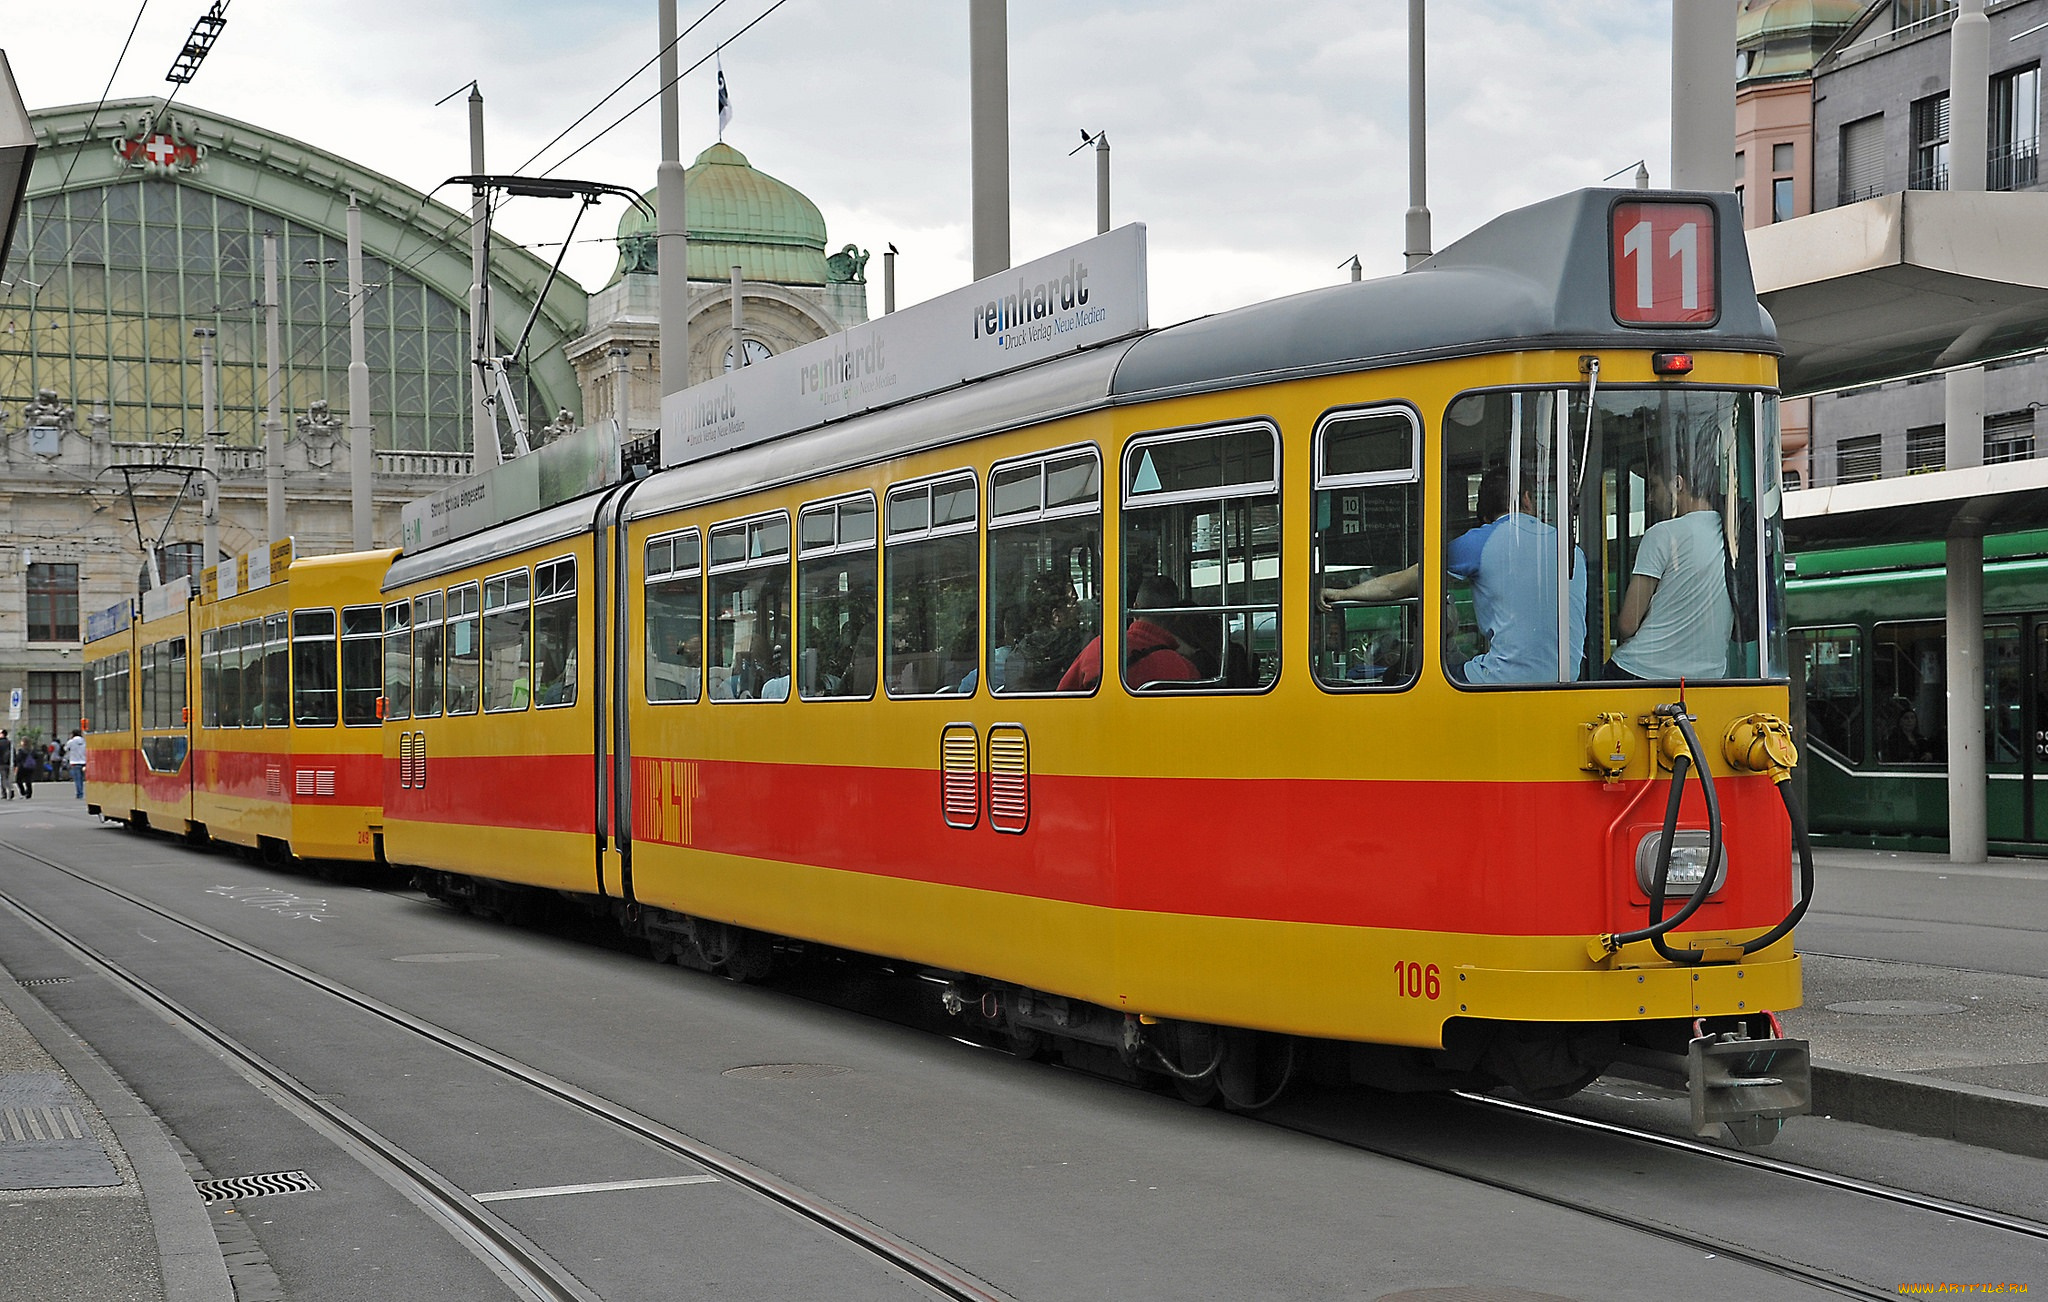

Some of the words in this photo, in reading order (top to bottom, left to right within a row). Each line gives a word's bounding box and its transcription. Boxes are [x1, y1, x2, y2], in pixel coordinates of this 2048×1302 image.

[1623, 220, 1699, 311] 11
[973, 258, 1089, 340] reinhardt
[1005, 330, 1027, 350] Druck
[1028, 324, 1052, 341] Verlag
[1054, 317, 1075, 335] Neue
[1075, 306, 1106, 329] Medien
[801, 331, 885, 395] reinhardt
[191, 484, 205, 497] 15
[460, 482, 485, 507] eingesetzt
[1344, 499, 1358, 511] 10
[639, 760, 699, 845] BLT
[358, 831, 369, 844] 249
[1394, 960, 1441, 1000] 106
